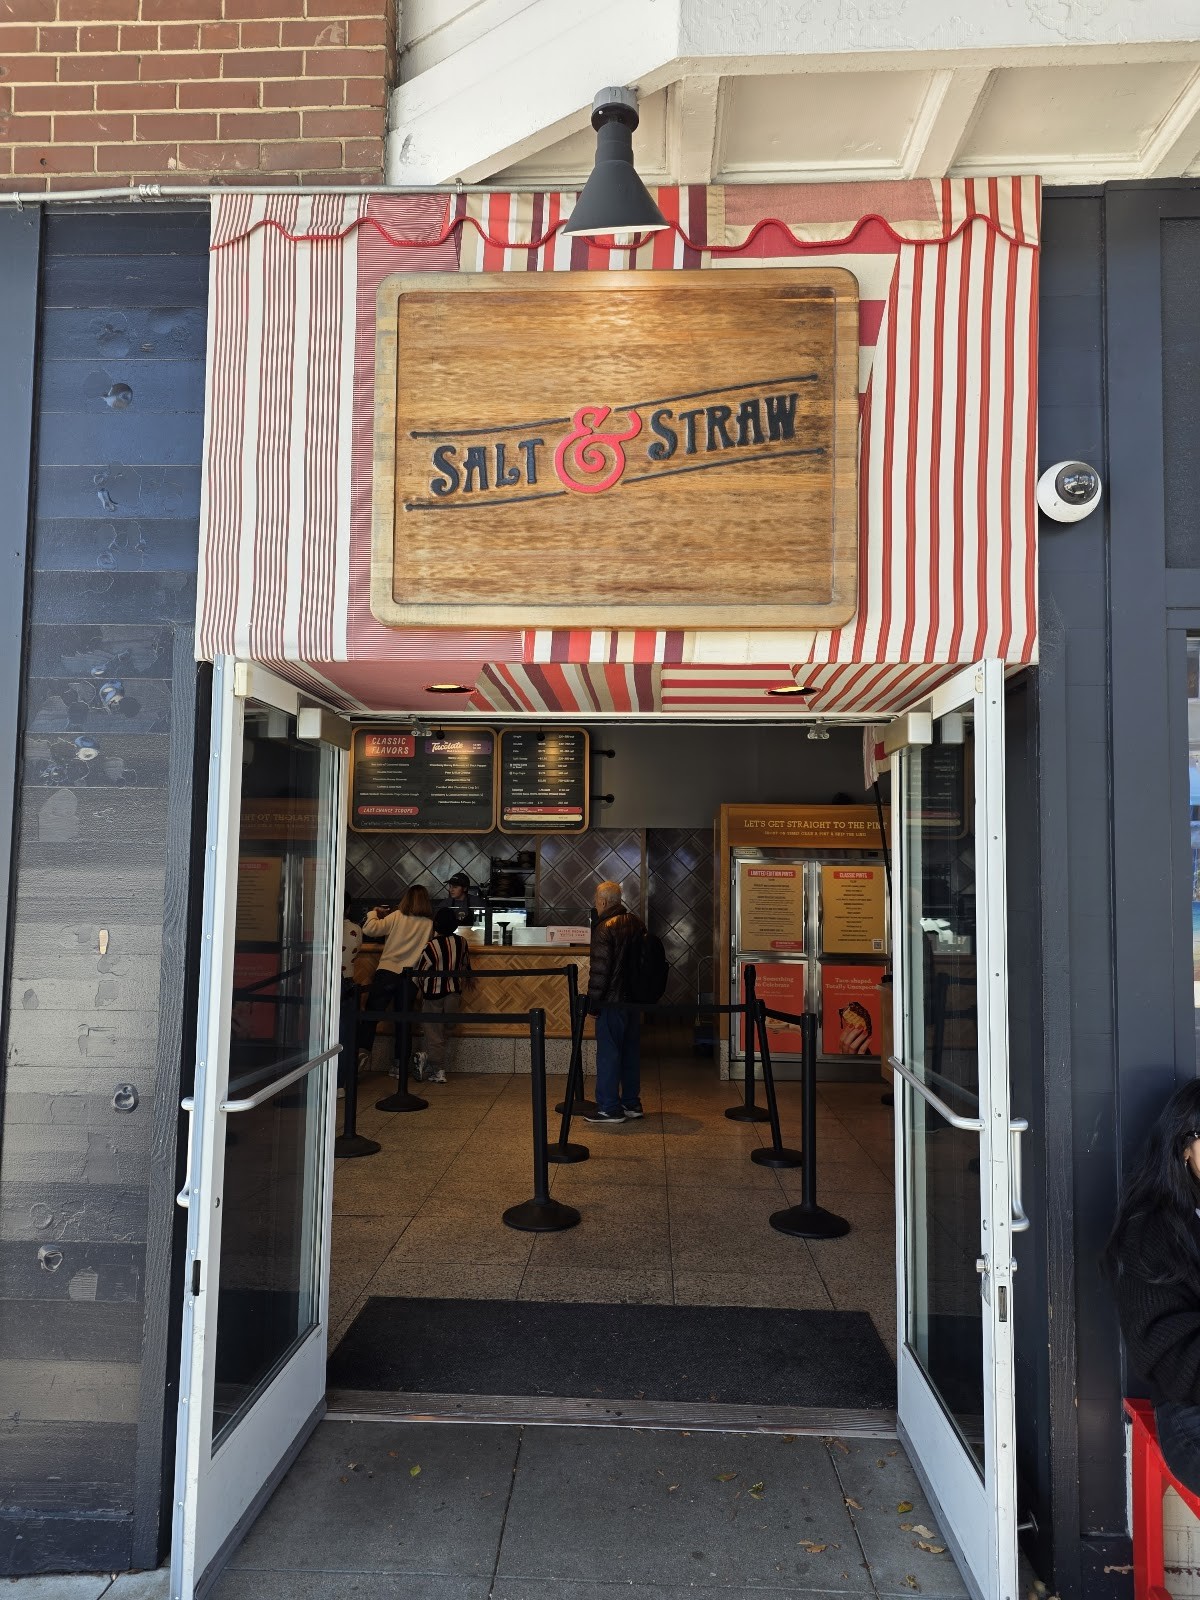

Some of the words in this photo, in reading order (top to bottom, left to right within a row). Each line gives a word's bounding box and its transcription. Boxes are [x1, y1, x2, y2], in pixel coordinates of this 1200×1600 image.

[430, 438, 545, 497] SALT
[555, 406, 642, 494] &
[648, 393, 799, 461] STRAW
[372, 737, 407, 745] CLASSIC
[371, 746, 409, 754] FLAVORS
[744, 820, 766, 828] LET'S
[786, 820, 831, 828] STRAIGHT
